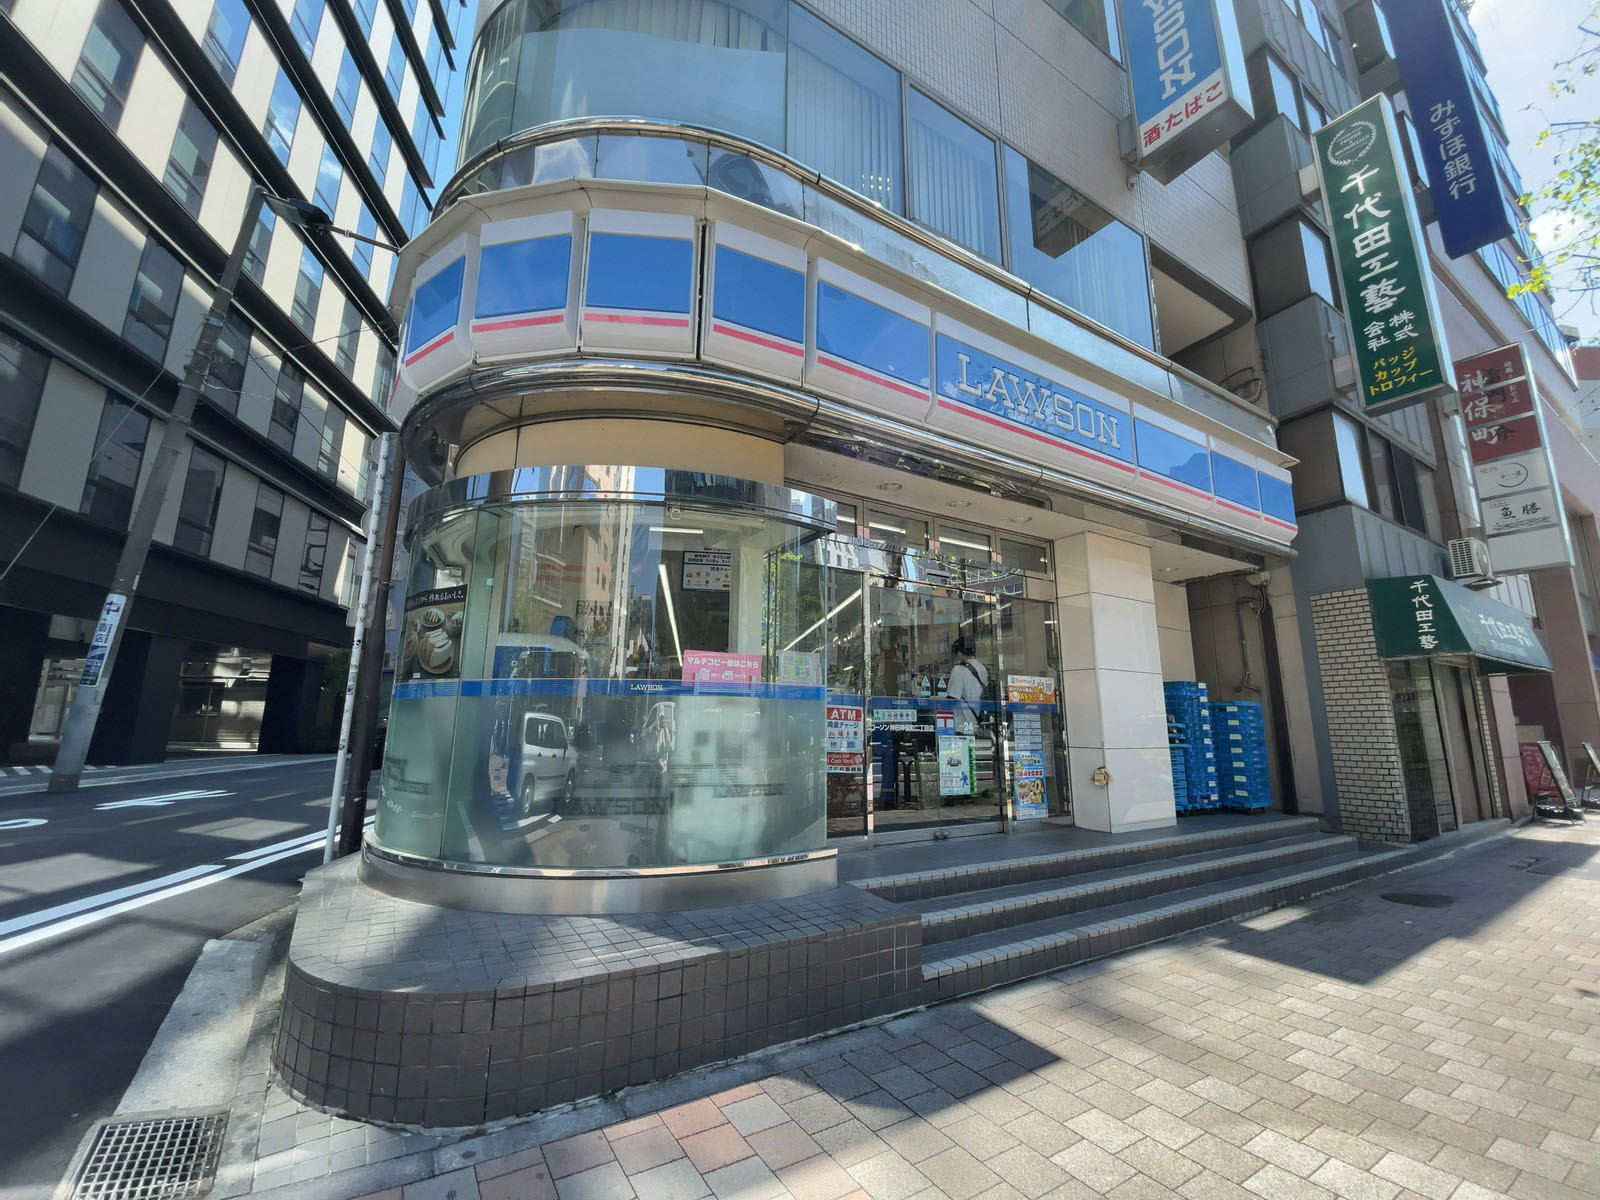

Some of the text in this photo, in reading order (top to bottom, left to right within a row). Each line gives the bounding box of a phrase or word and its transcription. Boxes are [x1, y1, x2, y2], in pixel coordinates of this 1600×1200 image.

[1429, 99, 1477, 201] みずほ銀行
[1369, 368, 1434, 397] トロフィー
[1374, 358, 1418, 383] カップ
[957, 352, 1121, 450] LAWSON
[1460, 369, 1501, 445] 神保町
[1409, 579, 1439, 650] 千代田工藝
[630, 683, 665, 691] LAWSON
[830, 709, 857, 721] ATM
[963, 721, 974, 731] 24
